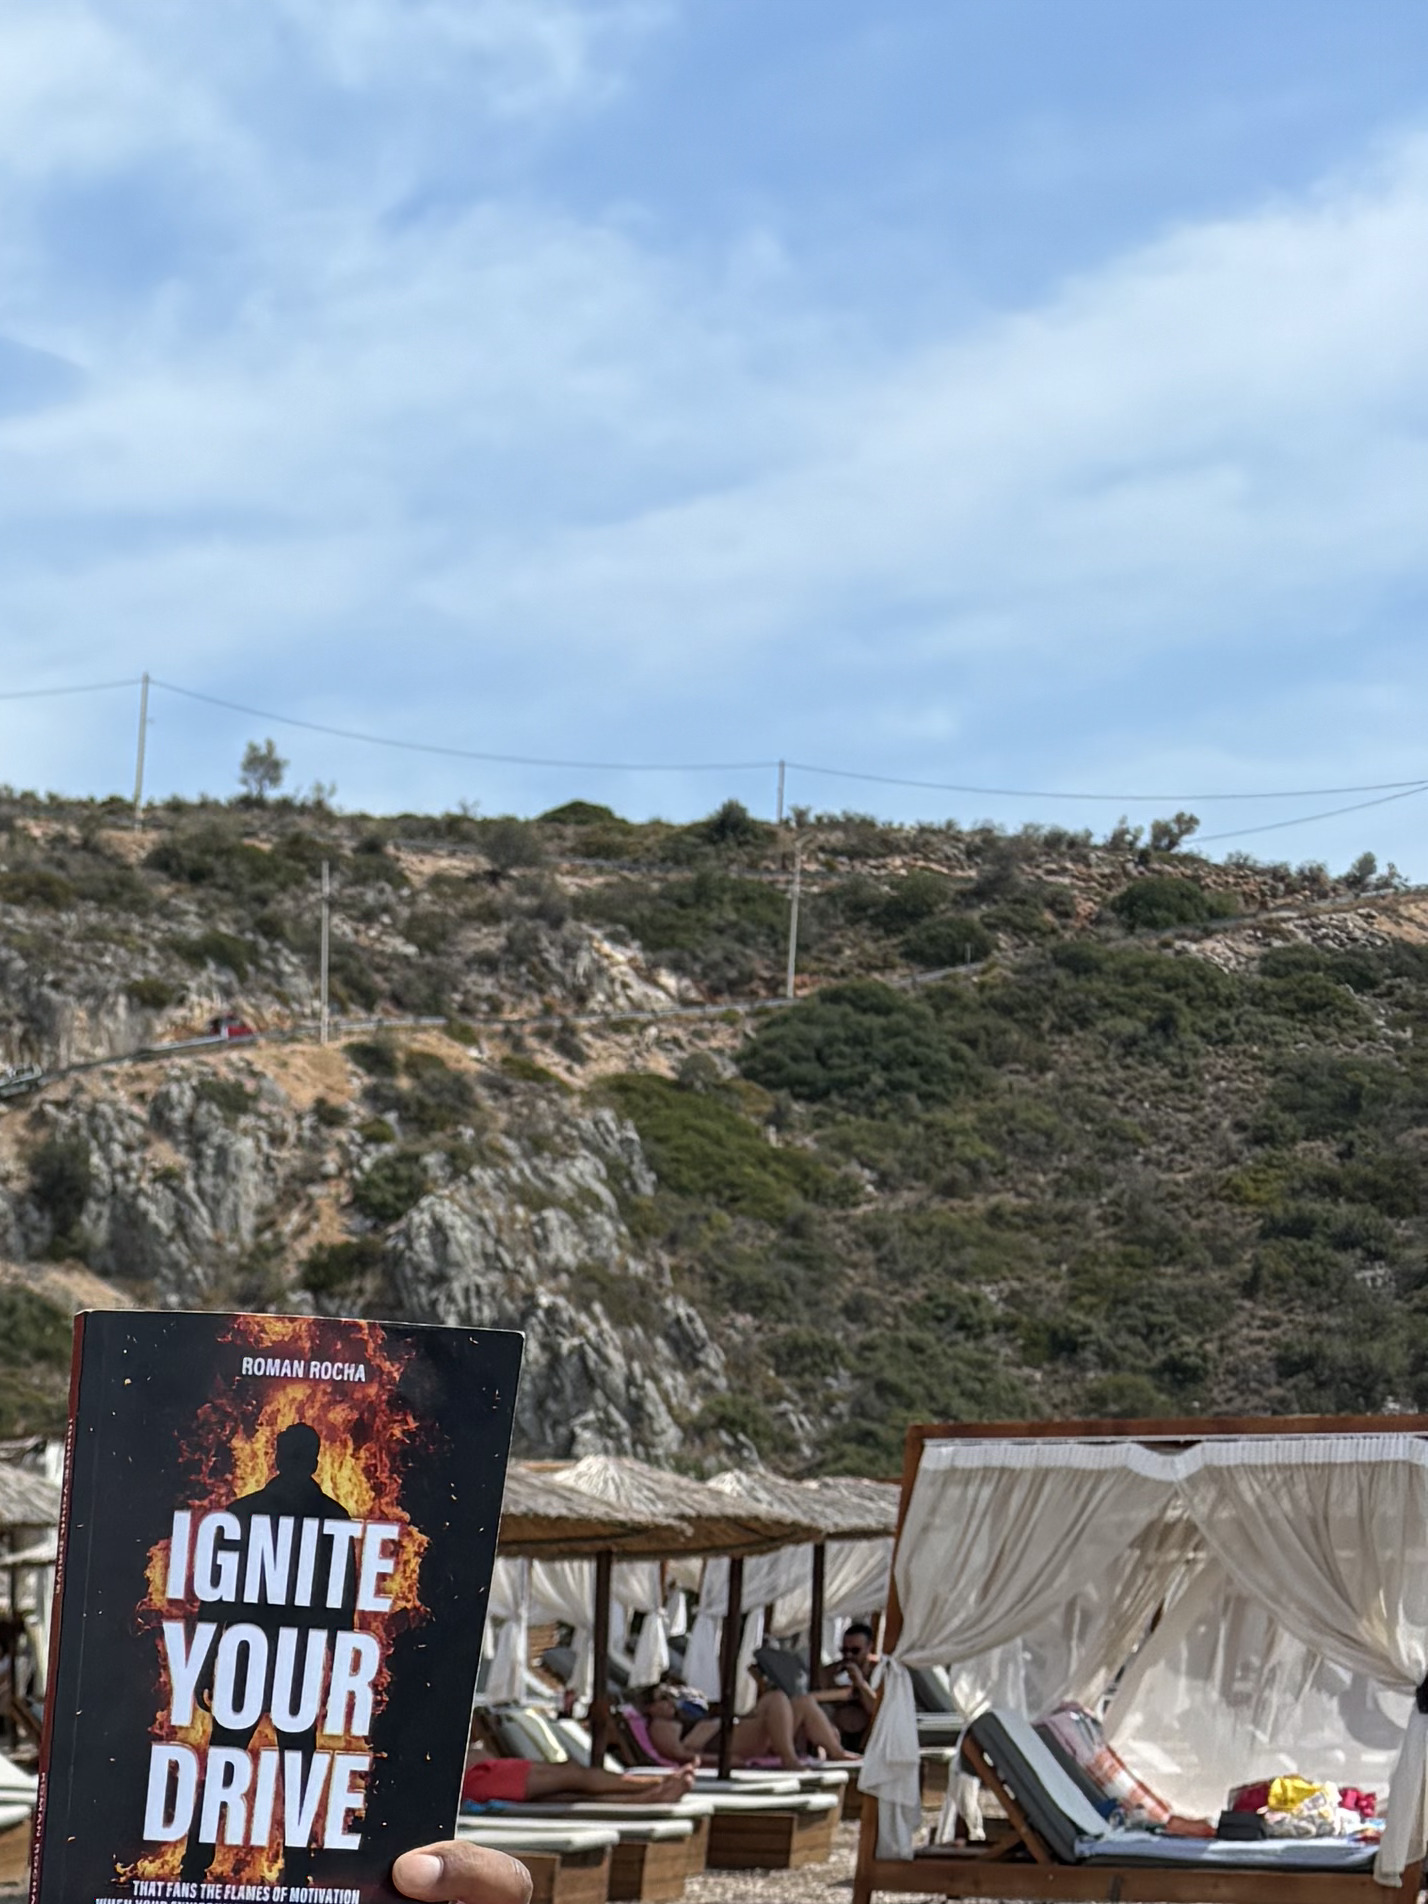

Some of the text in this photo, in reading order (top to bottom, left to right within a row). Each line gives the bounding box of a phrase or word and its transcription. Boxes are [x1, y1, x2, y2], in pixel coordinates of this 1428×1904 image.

[241, 1356, 366, 1382] ROMAN ROCHA
[165, 1510, 400, 1613] IGNITE
[162, 1620, 379, 1737] YOUR
[143, 1742, 371, 1850] DRIVE
[132, 1880, 361, 1904] THAT FANS THE FLAMES OF MOTIVATION
